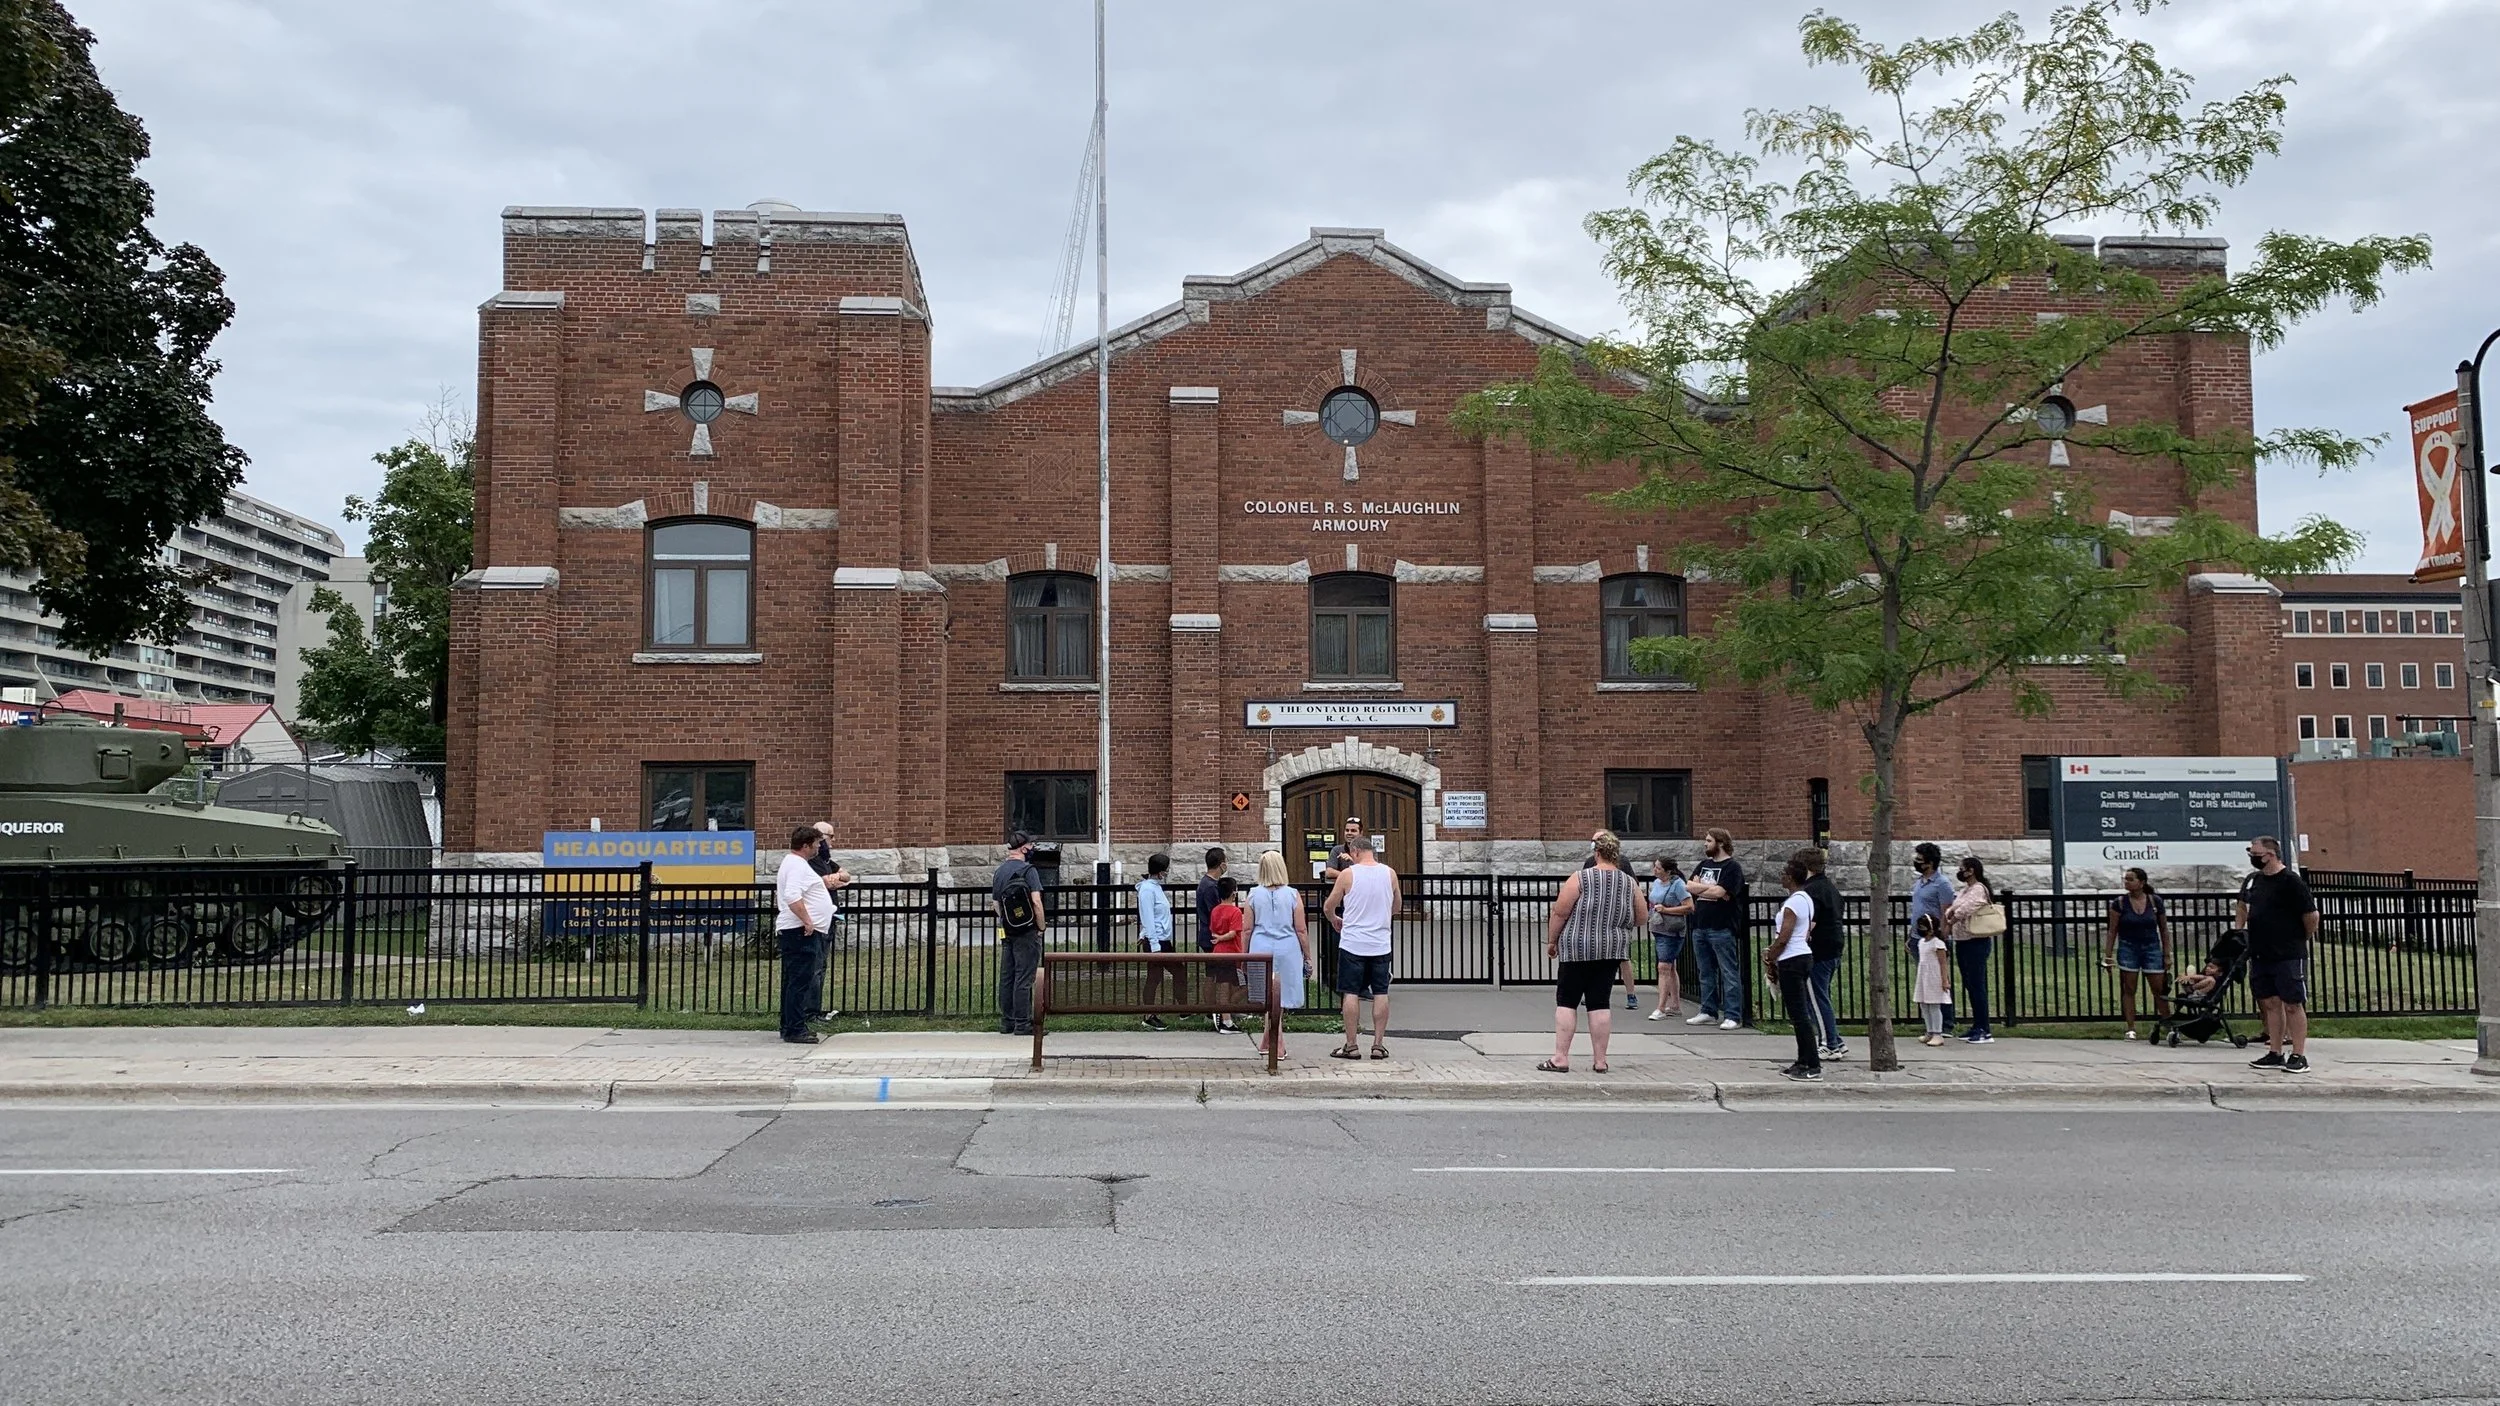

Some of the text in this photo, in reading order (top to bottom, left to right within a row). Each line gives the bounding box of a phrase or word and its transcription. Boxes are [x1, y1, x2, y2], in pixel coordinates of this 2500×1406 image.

[2413, 407, 2458, 434] SUPPORT
[1244, 501, 1460, 514] COLONEL R. S. McLAUGHLIN
[1312, 519, 1389, 532] ARMOURY
[2430, 551, 2462, 567] TROOPS
[1280, 705, 1424, 713] THE ONTARIO REGIMENT
[0, 709, 19, 724] AW
[1237, 797, 1244, 806] 4
[2100, 791, 2179, 801] Col RS McLaughlin
[2188, 791, 2256, 800] Manège militaire
[2100, 801, 2136, 810] Armoury
[2189, 800, 2268, 810] Col RS McLaughlin
[0, 822, 64, 835] QUEROR
[2101, 817, 2116, 828] 53
[2189, 817, 2208, 829] 53,
[553, 841, 744, 857] HEADQUARTERS
[2102, 845, 2159, 861] Canada
